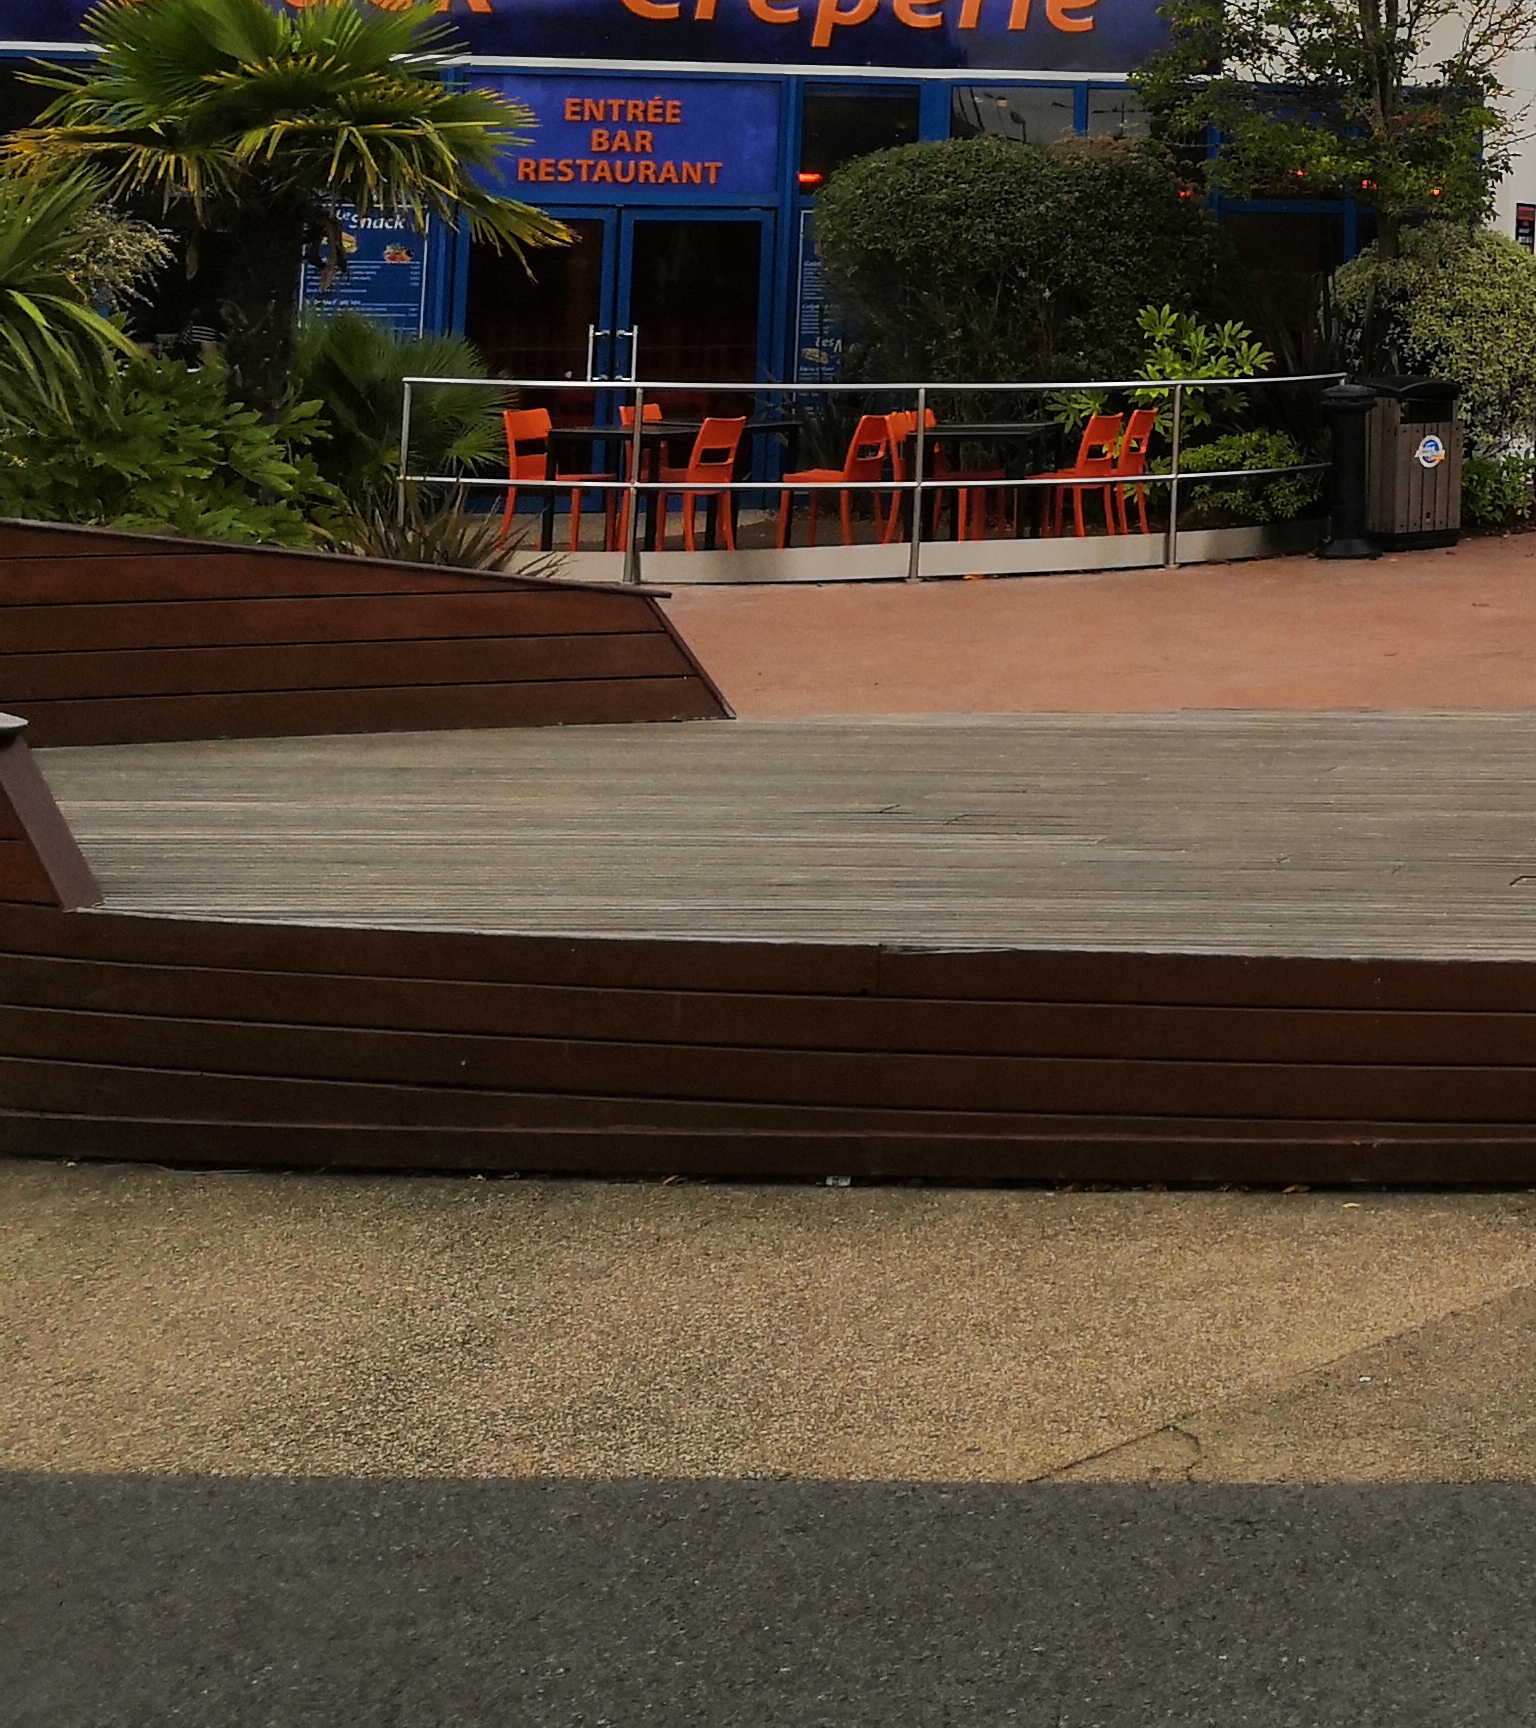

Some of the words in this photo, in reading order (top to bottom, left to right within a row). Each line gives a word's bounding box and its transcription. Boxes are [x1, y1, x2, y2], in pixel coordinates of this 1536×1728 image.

[564, 96, 682, 124] ENTRÉE
[590, 128, 653, 153] BAR
[517, 158, 723, 184] RESTAURANT
